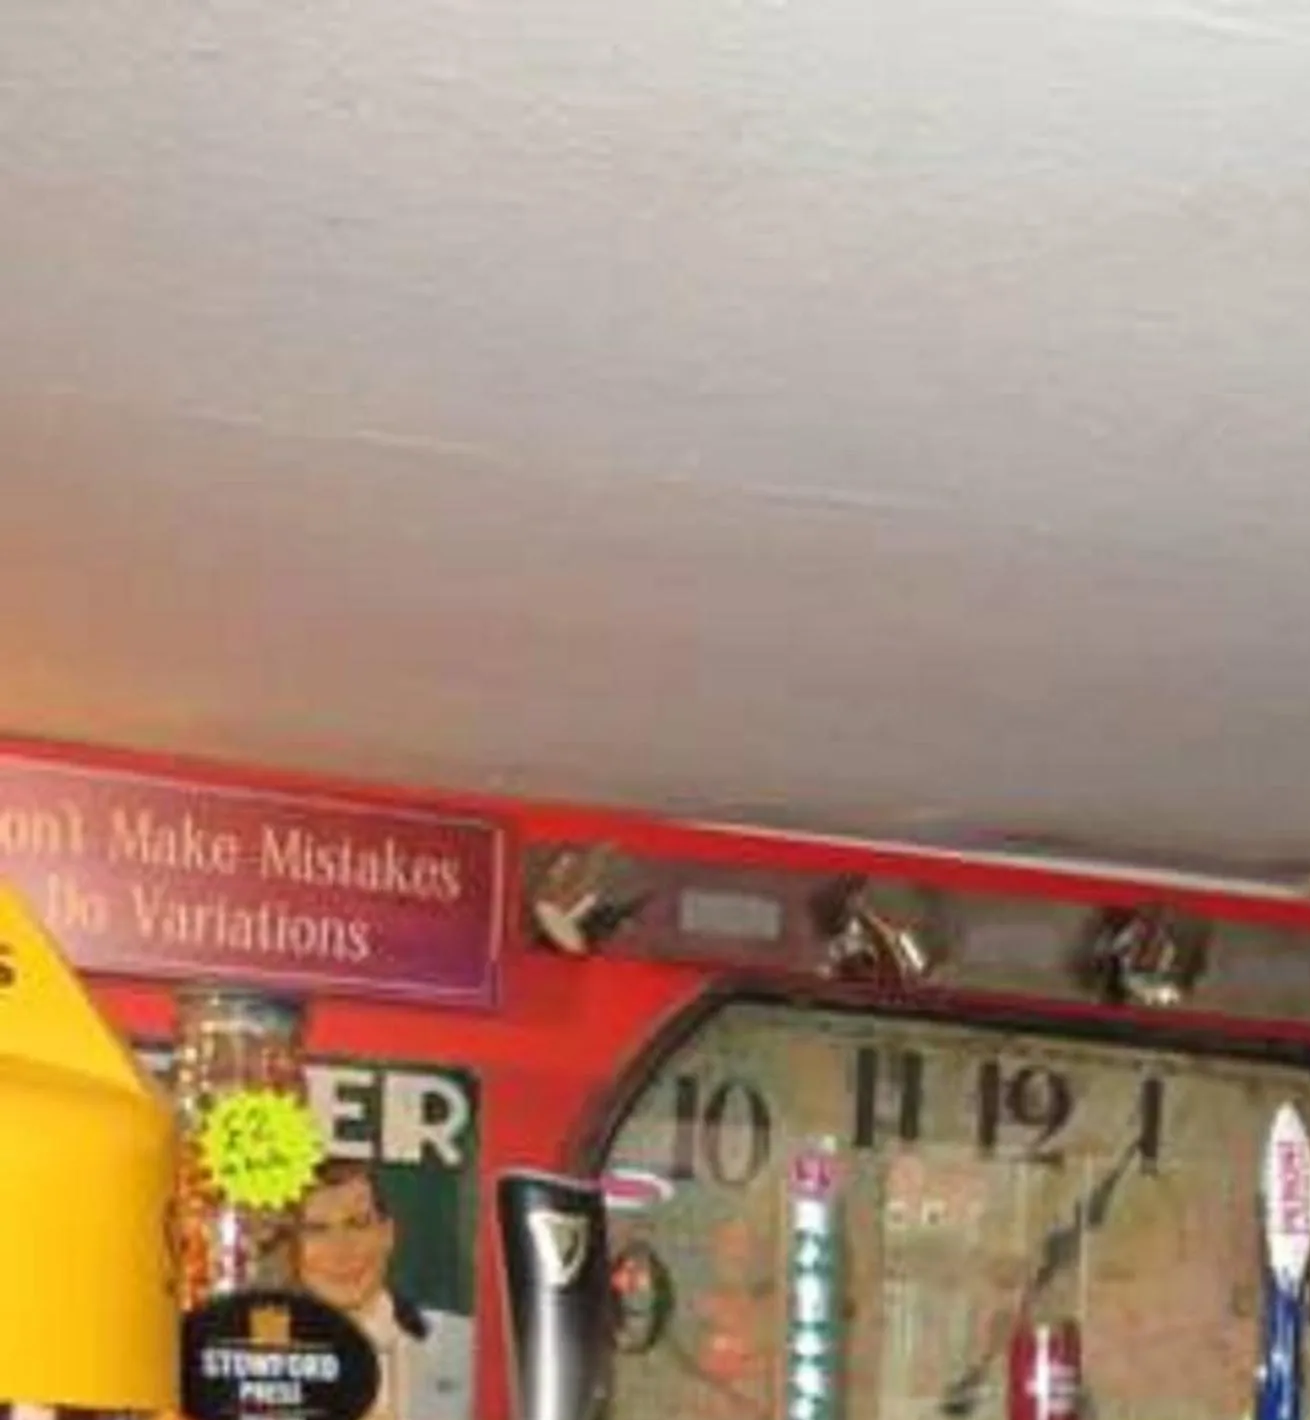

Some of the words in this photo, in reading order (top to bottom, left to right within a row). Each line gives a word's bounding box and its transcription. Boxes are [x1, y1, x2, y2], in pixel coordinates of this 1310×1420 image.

[109, 810, 241, 876] Make
[260, 824, 463, 903] Mistakes
[132, 884, 373, 963] Variations
[672, 1074, 771, 1190] 10
